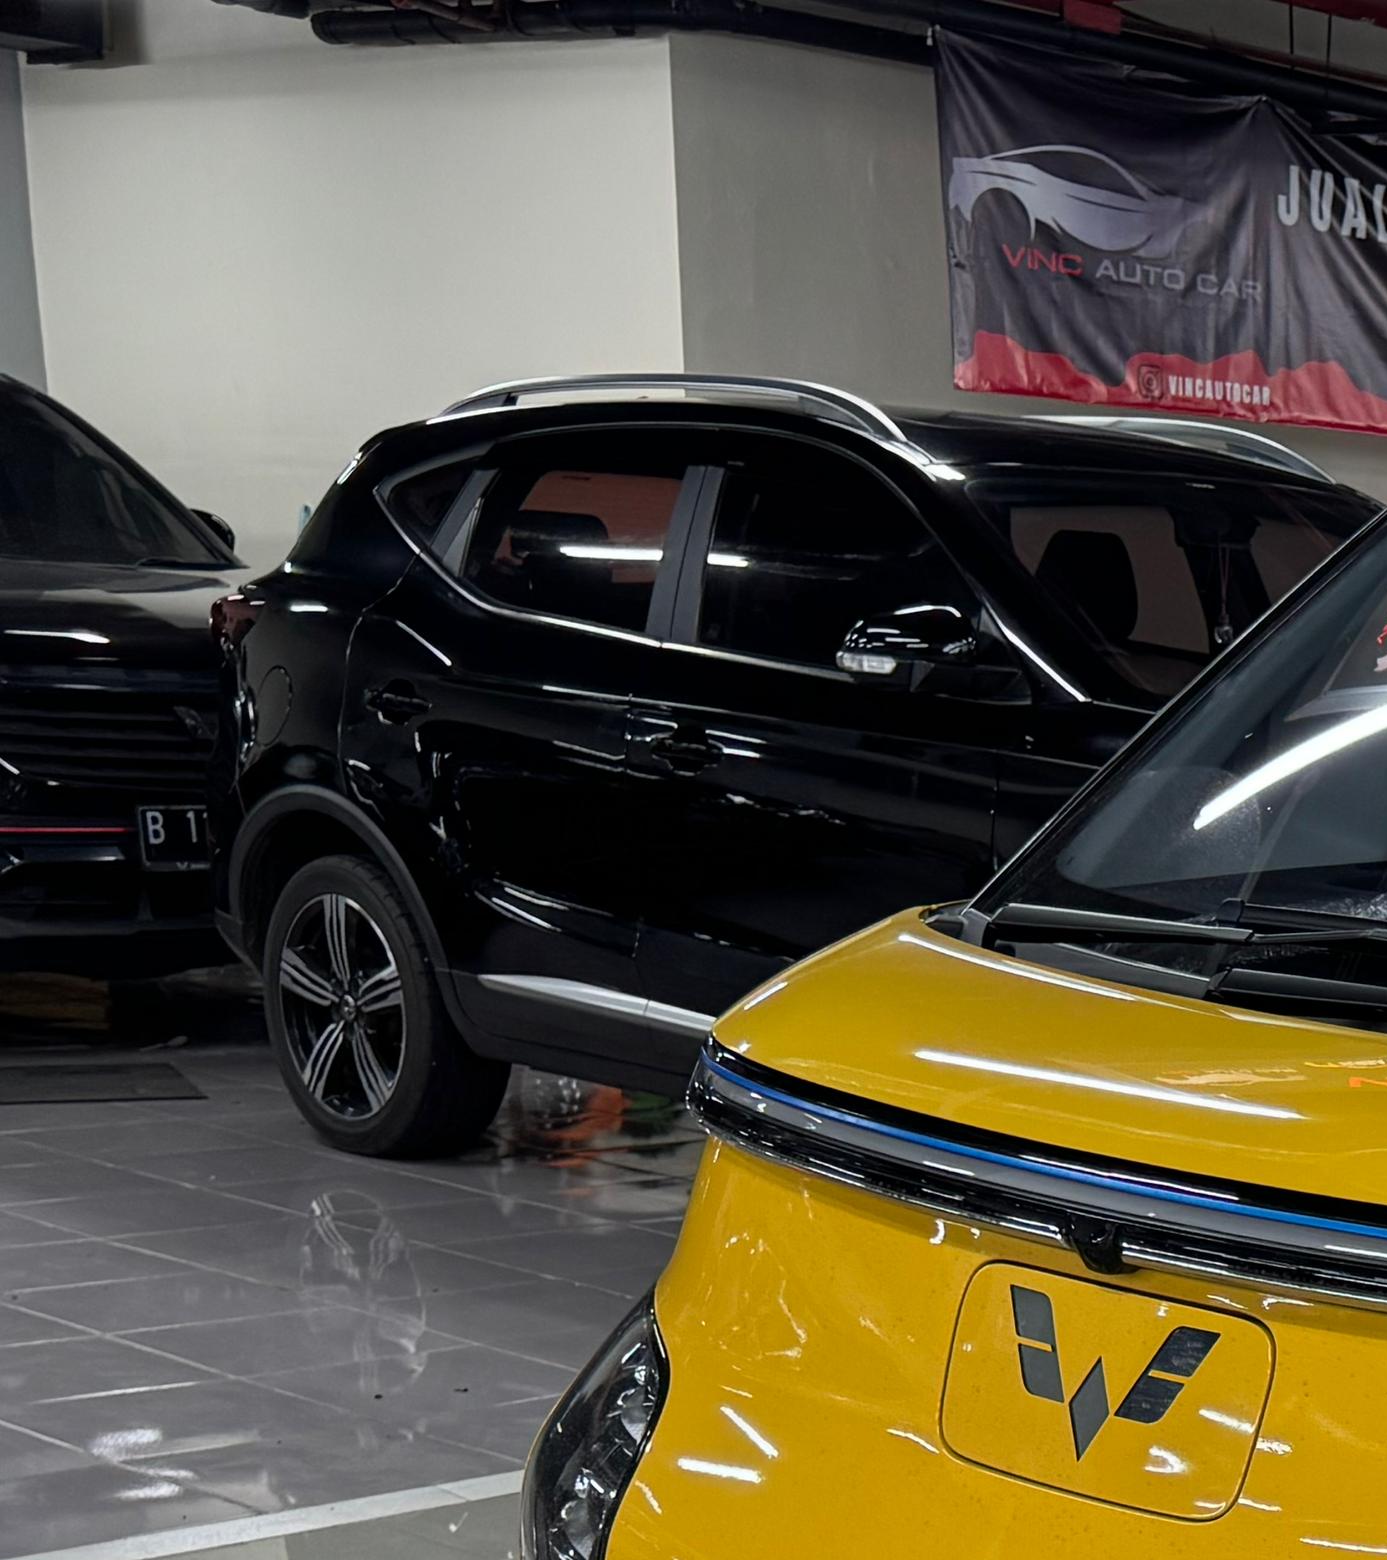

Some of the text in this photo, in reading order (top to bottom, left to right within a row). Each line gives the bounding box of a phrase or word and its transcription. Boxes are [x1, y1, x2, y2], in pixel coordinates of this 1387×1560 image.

[1001, 243, 1262, 301] VINC AUTO CAR
[1168, 374, 1272, 407] VINCAUTOCAR
[146, 811, 166, 845] B
